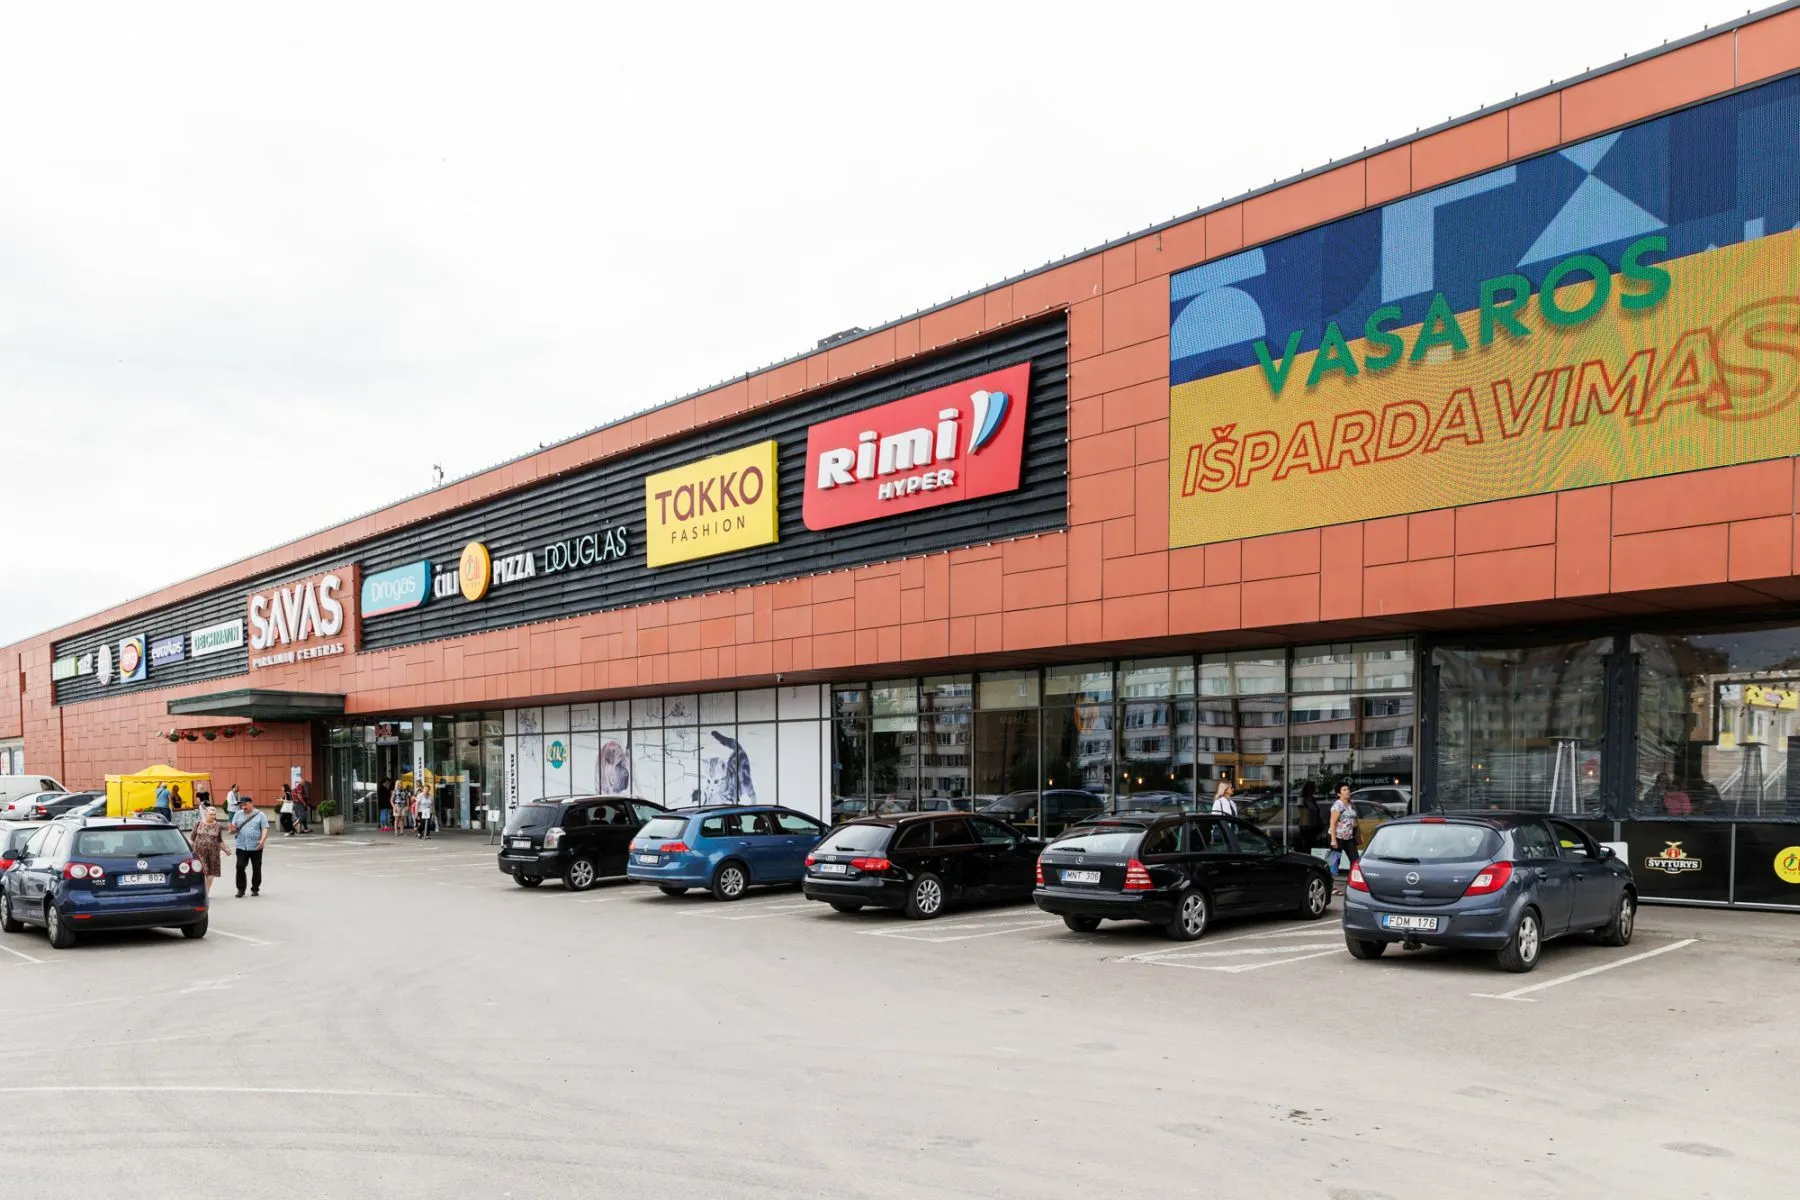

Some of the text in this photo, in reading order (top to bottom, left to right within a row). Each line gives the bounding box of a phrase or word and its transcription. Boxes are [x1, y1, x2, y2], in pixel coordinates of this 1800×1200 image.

[1254, 236, 1671, 396] VASAROS
[1182, 295, 1800, 498] IŠPARDAVIMAS
[878, 468, 955, 501] HYPER
[671, 515, 745, 544] FASHION
[545, 528, 627, 573] DOUGLAS
[493, 551, 536, 585] PIZZA
[371, 574, 416, 602] Drogas
[251, 574, 344, 650] SAVAS
[296, 643, 345, 660] CENTRAS
[1067, 871, 1099, 881] MNT 306
[1648, 857, 1698, 869] ŠVYTURYS
[124, 874, 164, 883] LCF 802
[1389, 916, 1435, 928] FDM 176
